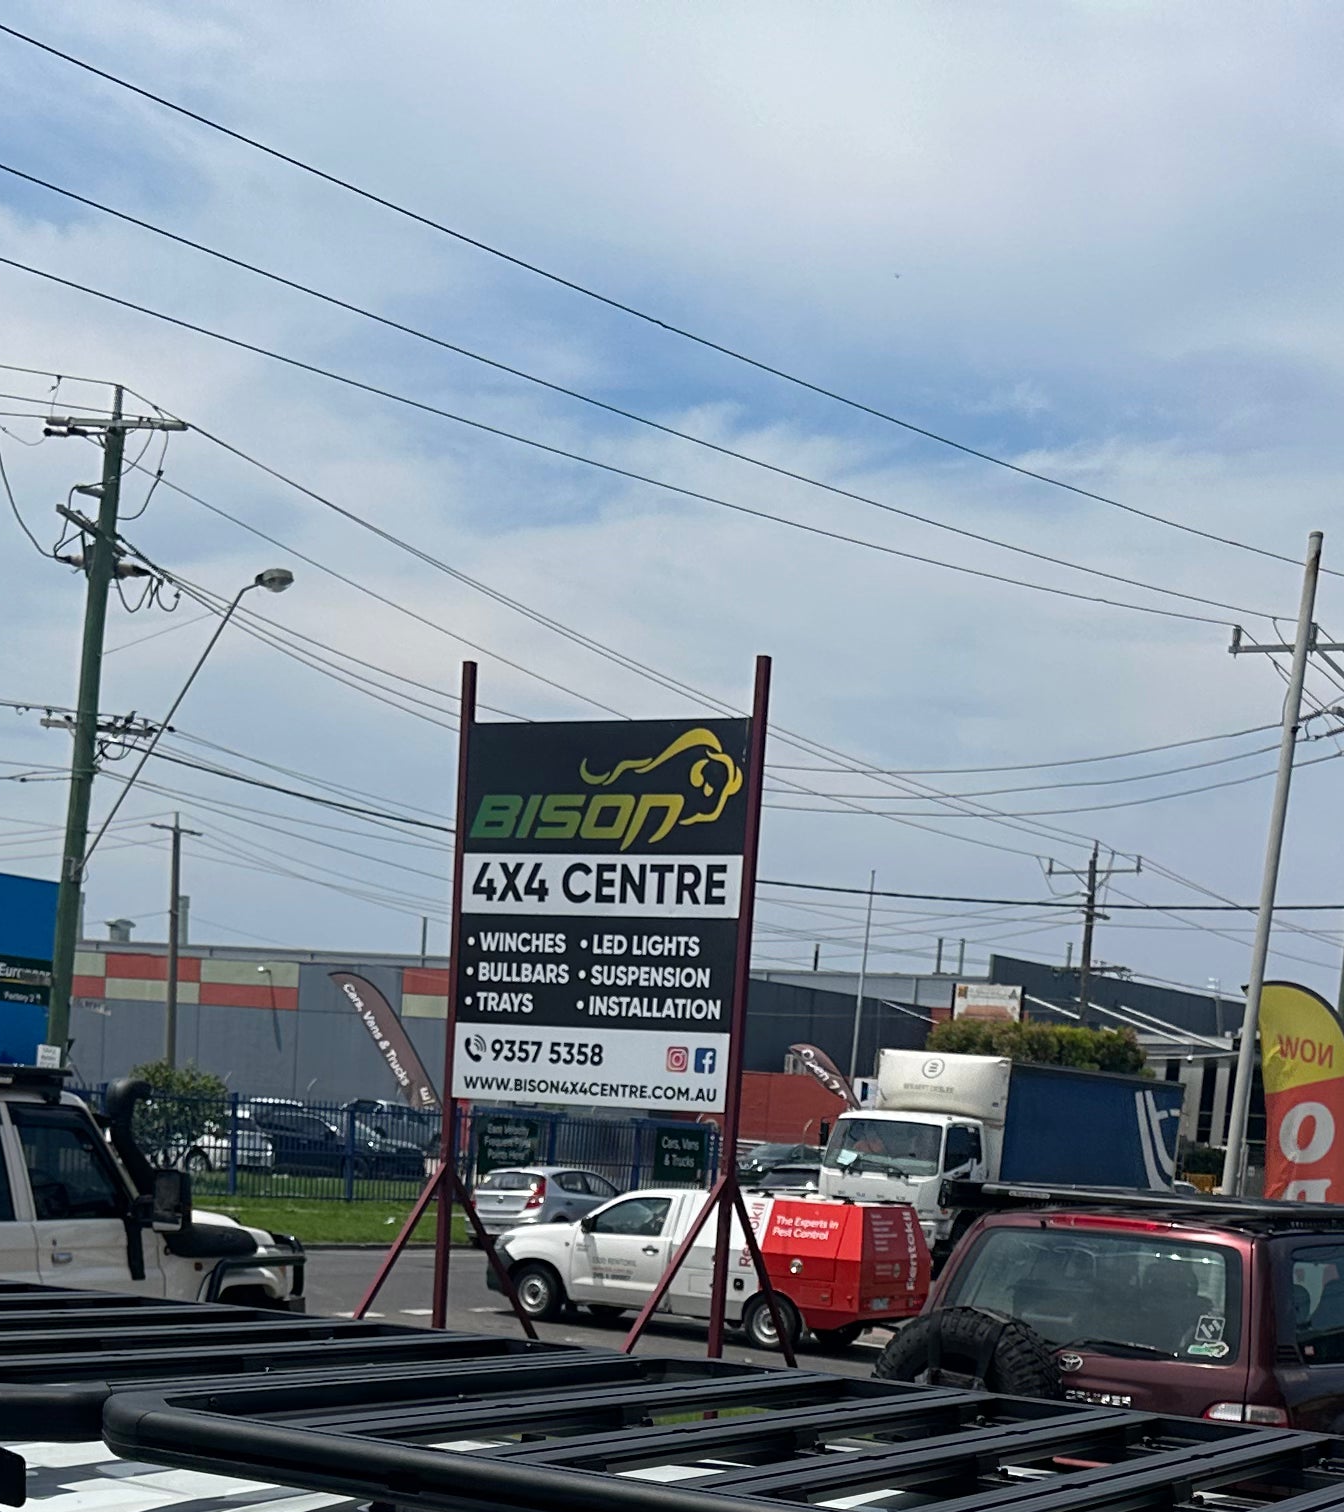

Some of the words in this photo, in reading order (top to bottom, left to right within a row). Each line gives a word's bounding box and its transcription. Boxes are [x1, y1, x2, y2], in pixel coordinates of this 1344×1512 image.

[472, 862, 549, 902] 4X4
[562, 863, 728, 905] CENTRE
[479, 932, 567, 954] WINCHES
[592, 934, 628, 955] LED
[632, 936, 700, 957] LIGHTS
[478, 962, 570, 984] BULLBARS
[590, 965, 710, 988] SUSPENSION
[476, 991, 534, 1013] TRAYS
[588, 996, 722, 1020] INSTALLATION
[363, 1010, 383, 1039] Vans
[378, 1040, 390, 1050] &
[386, 1049, 410, 1086] Trucks
[491, 1039, 543, 1064] 9357
[548, 1041, 604, 1066] 5358
[463, 1075, 717, 1102] WWW.BISON4X4CENTRE.COM.AU
[772, 1226, 793, 1238] Pest
[793, 1227, 830, 1241] Control
[777, 1215, 793, 1226] The
[794, 1216, 828, 1229] Experts
[739, 1202, 766, 1268] Reokil
